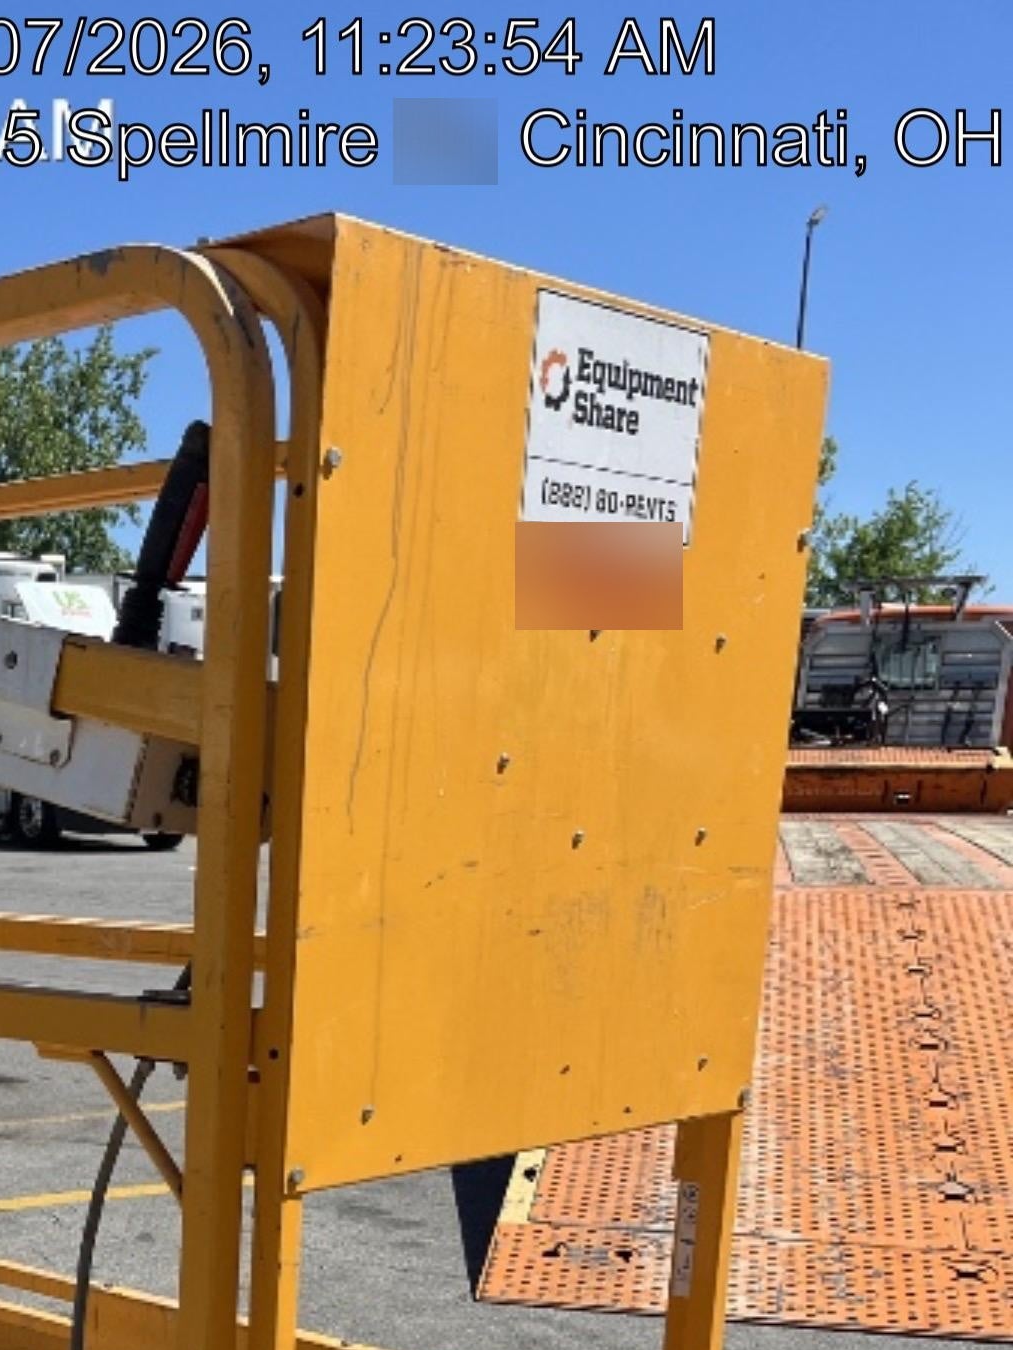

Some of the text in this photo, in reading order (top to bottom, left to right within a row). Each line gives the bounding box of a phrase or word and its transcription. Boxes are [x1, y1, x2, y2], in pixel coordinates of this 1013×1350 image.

[576, 347, 699, 408] Equipment
[572, 389, 639, 436] Share
[540, 476, 591, 513] (888)
